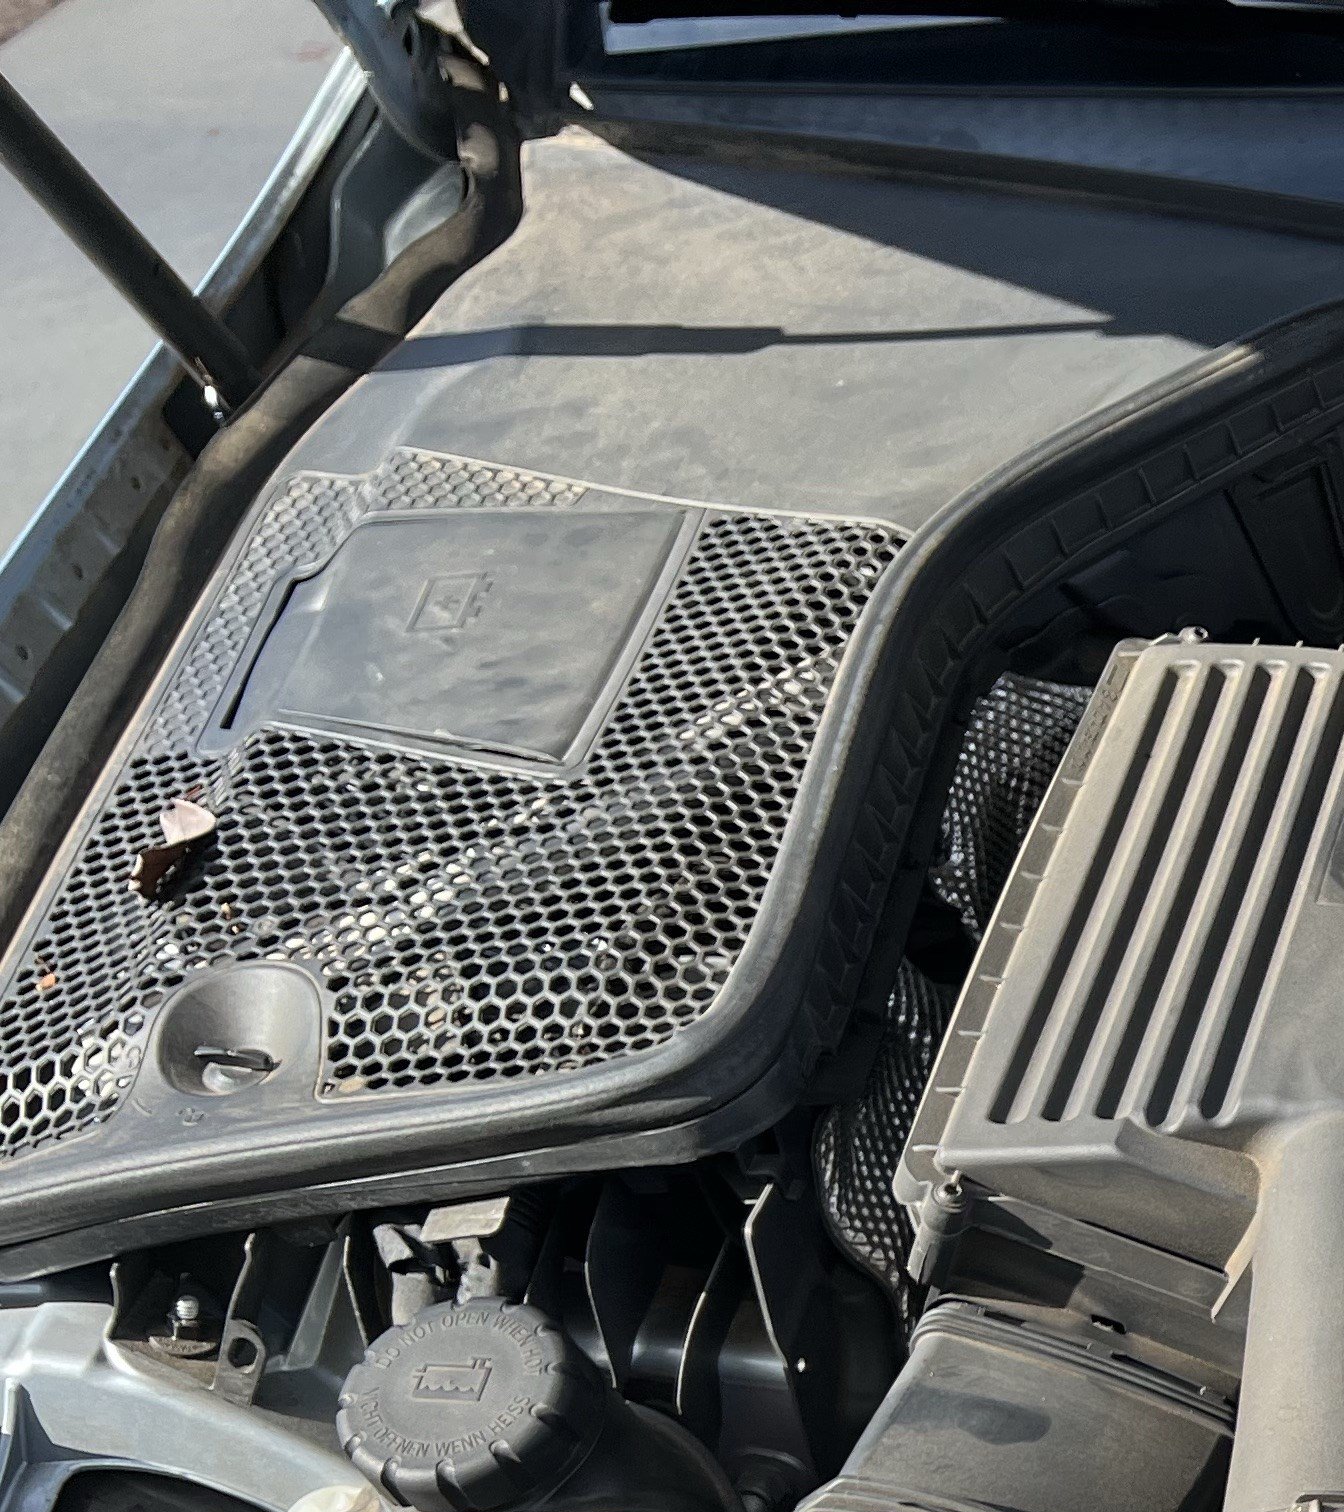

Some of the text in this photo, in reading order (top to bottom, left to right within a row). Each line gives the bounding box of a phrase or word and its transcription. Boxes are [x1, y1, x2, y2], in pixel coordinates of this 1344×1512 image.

[375, 1311, 545, 1377] DO NOT OPEN WHEN HOT
[434, 1430, 487, 1458] WENN
[490, 1395, 531, 1436] HEISS
